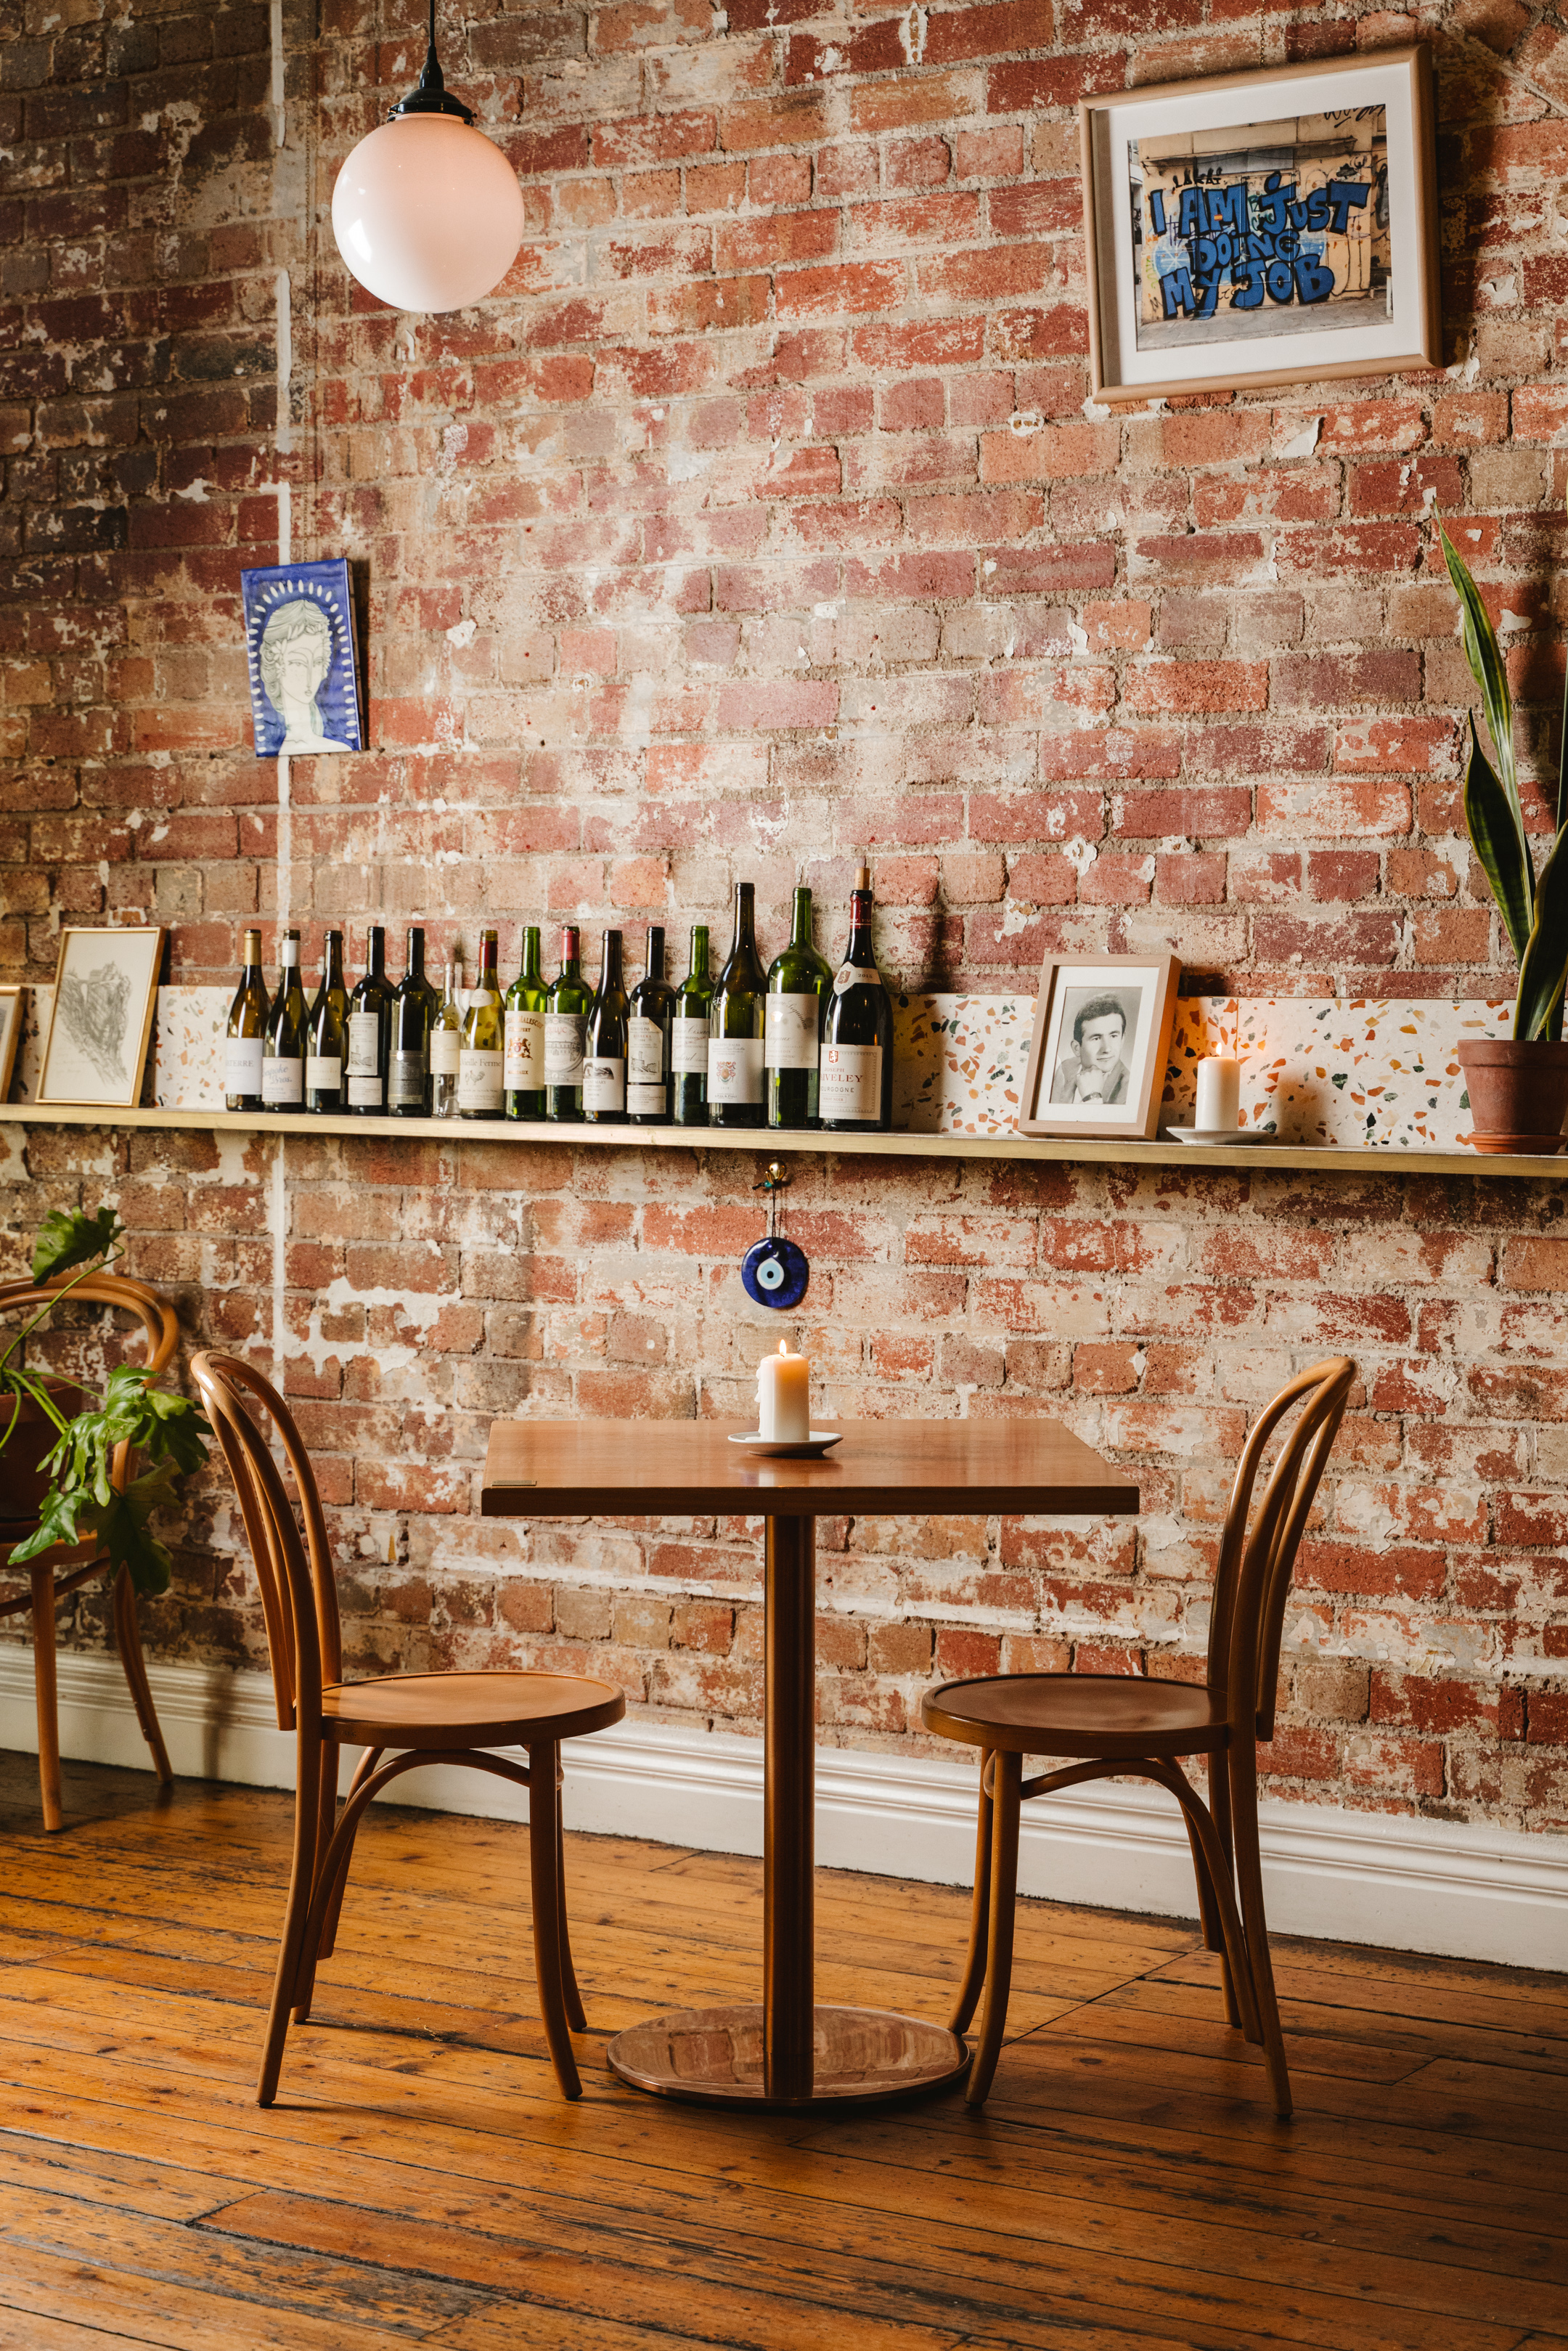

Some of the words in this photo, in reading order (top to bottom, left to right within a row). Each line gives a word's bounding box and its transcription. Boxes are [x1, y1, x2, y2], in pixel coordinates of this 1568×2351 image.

[1148, 189, 1167, 237] I
[1178, 182, 1251, 239] AM
[1159, 266, 1223, 321] MY
[1230, 253, 1336, 307] JOB
[479, 1058, 502, 1067] Ferme
